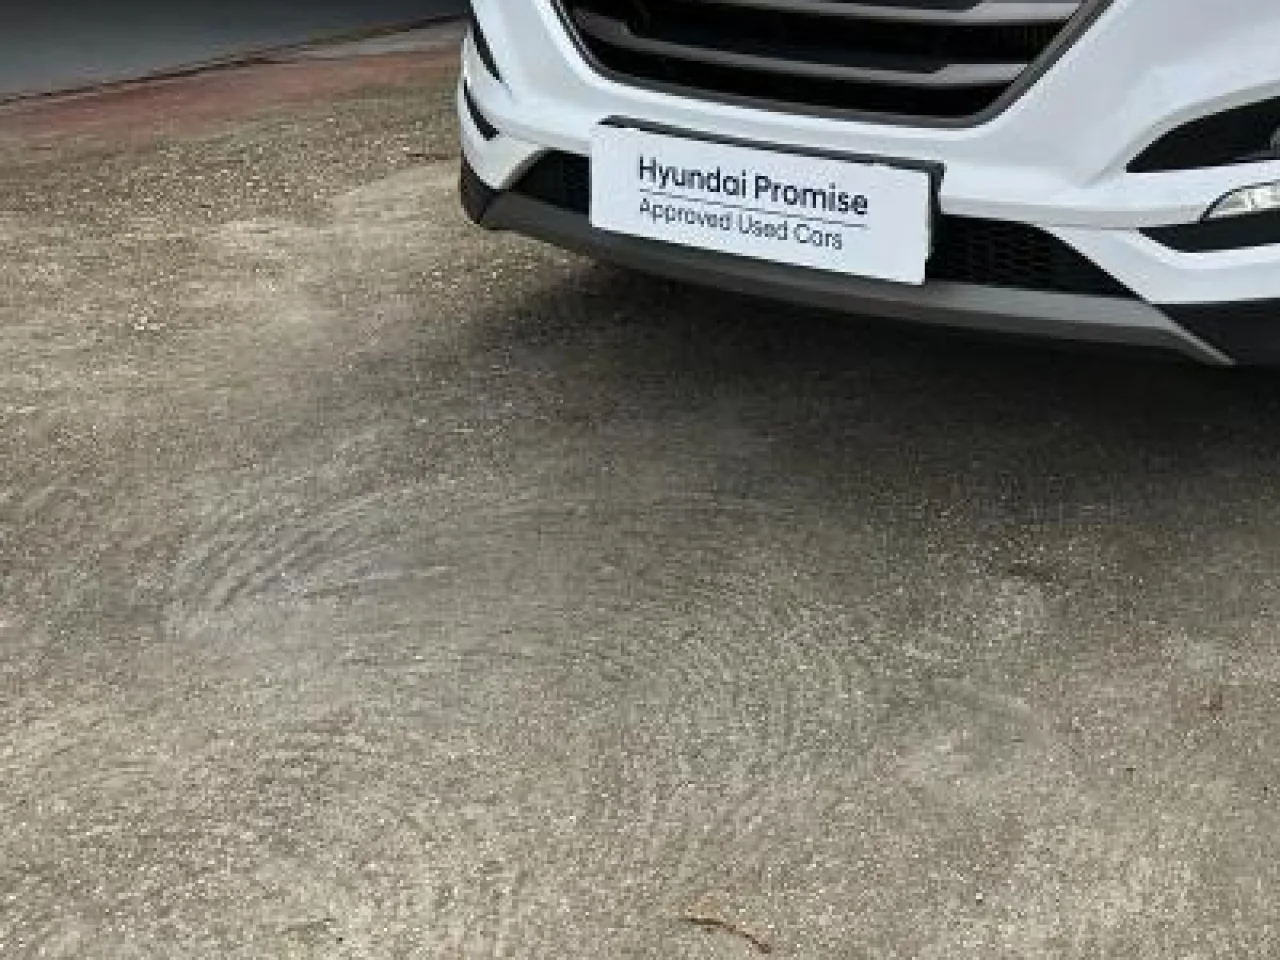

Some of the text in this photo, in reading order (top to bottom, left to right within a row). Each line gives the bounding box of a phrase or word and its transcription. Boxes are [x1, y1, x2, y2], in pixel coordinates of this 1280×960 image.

[639, 155, 868, 215] Hyundai Promise
[639, 197, 842, 250] Approved Used Cars
